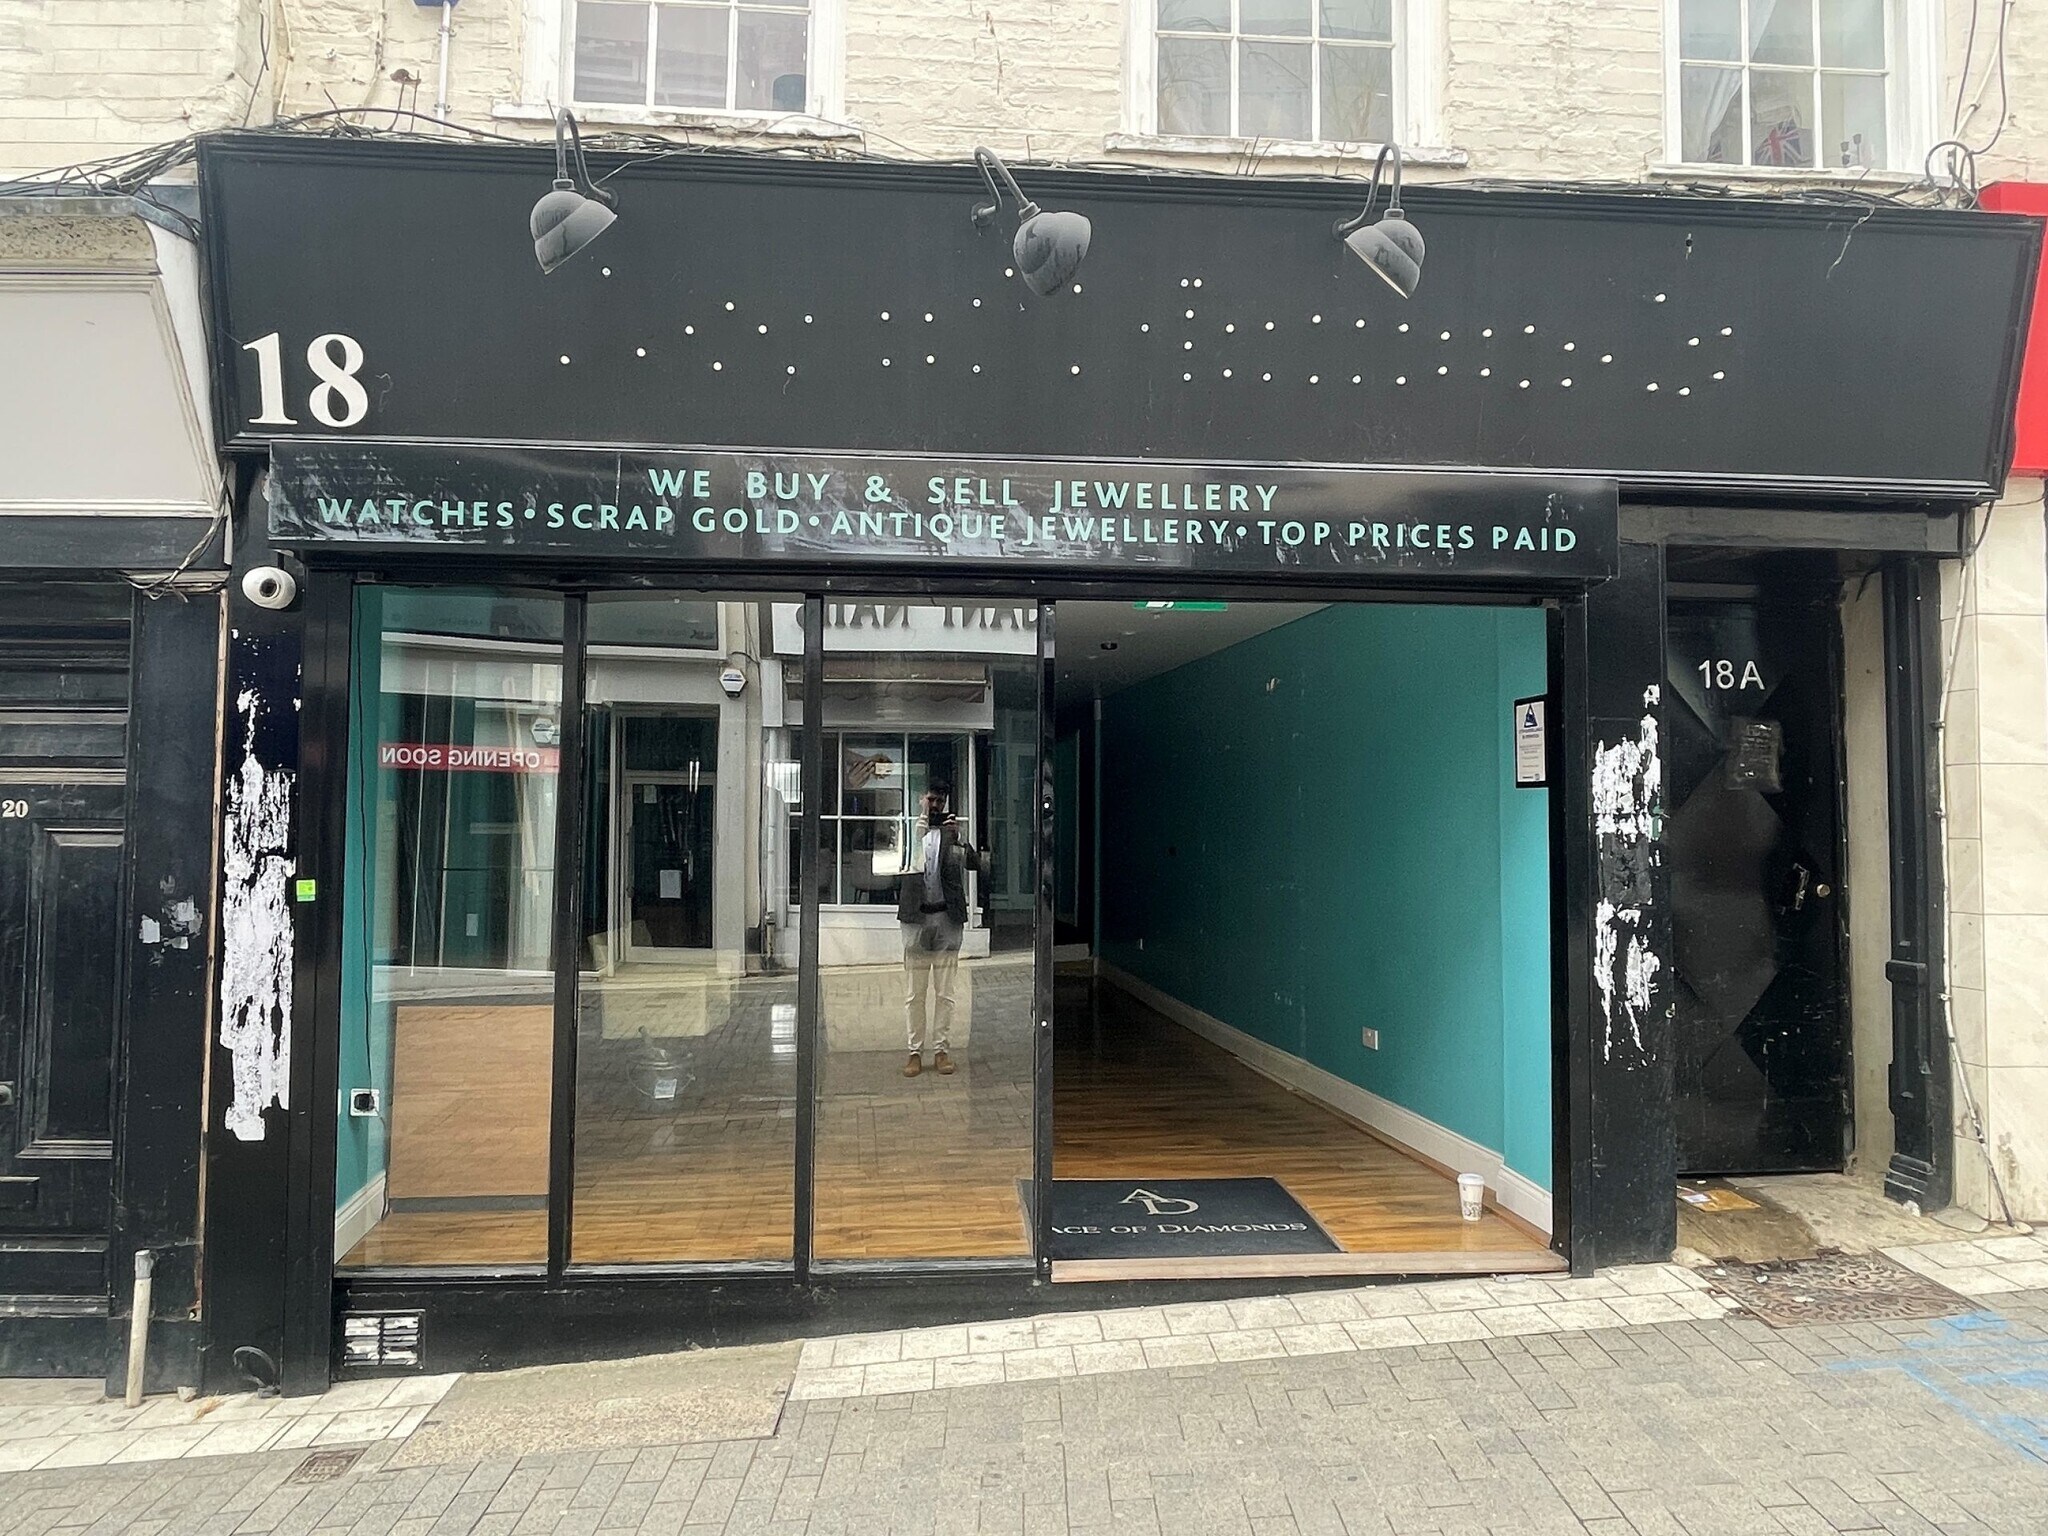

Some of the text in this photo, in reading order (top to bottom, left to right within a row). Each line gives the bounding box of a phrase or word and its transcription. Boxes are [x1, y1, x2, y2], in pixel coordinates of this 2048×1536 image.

[242, 332, 369, 428] 18
[648, 468, 1280, 514] WE BUY & SELL JEWELLERY
[1348, 523, 1475, 550] PRICES
[1491, 526, 1578, 552] PAID
[1698, 659, 1766, 690] 18A
[1, 799, 29, 818] 20
